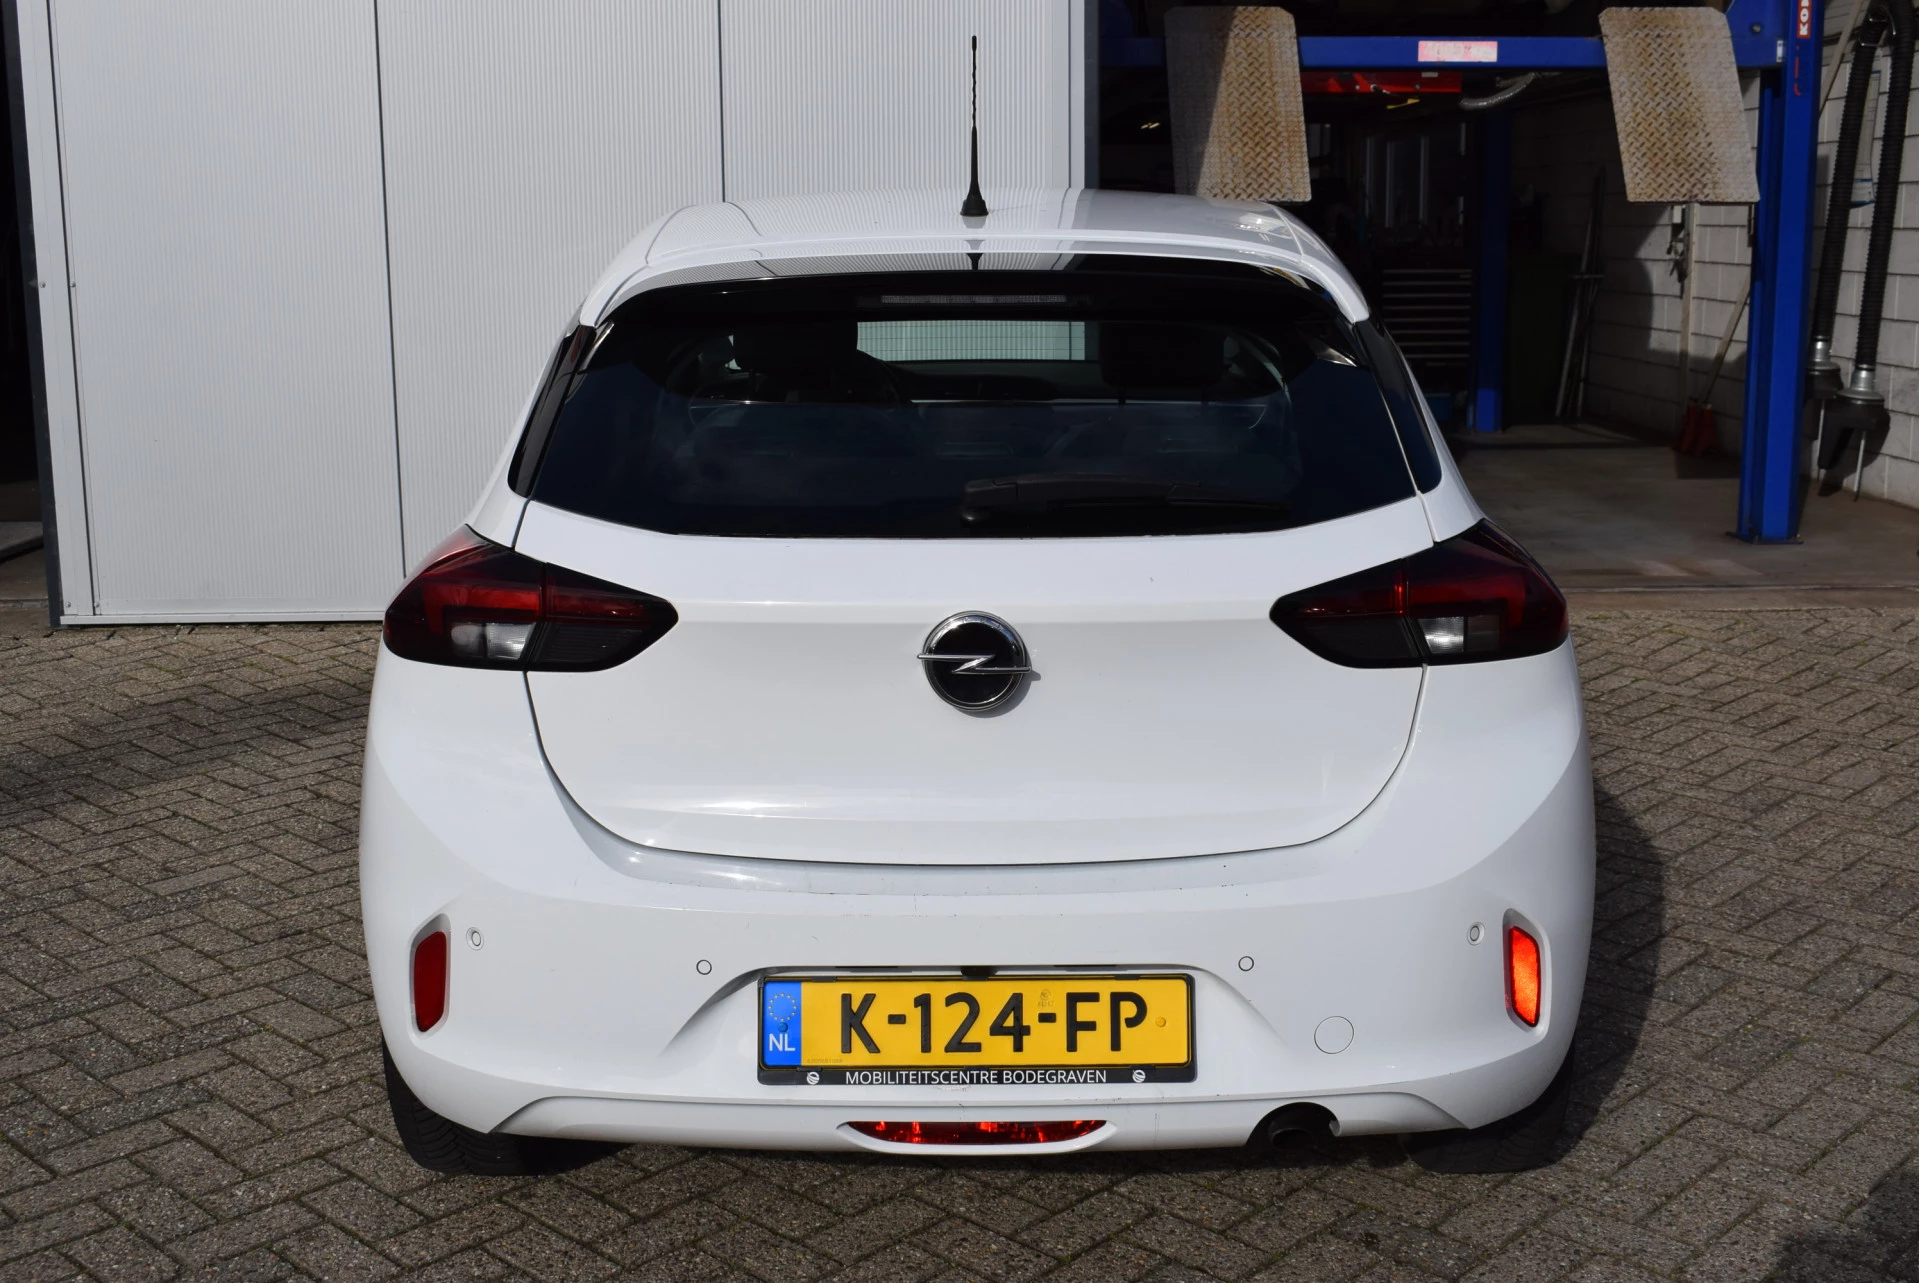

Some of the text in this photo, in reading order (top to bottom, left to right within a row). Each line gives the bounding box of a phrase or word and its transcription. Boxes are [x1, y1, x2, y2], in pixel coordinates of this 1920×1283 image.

[841, 991, 1148, 1054] K-124-FP
[768, 1033, 796, 1052] NL
[845, 1069, 1107, 1085] MOBILITEITSCENTRE BODEGRAVEN
